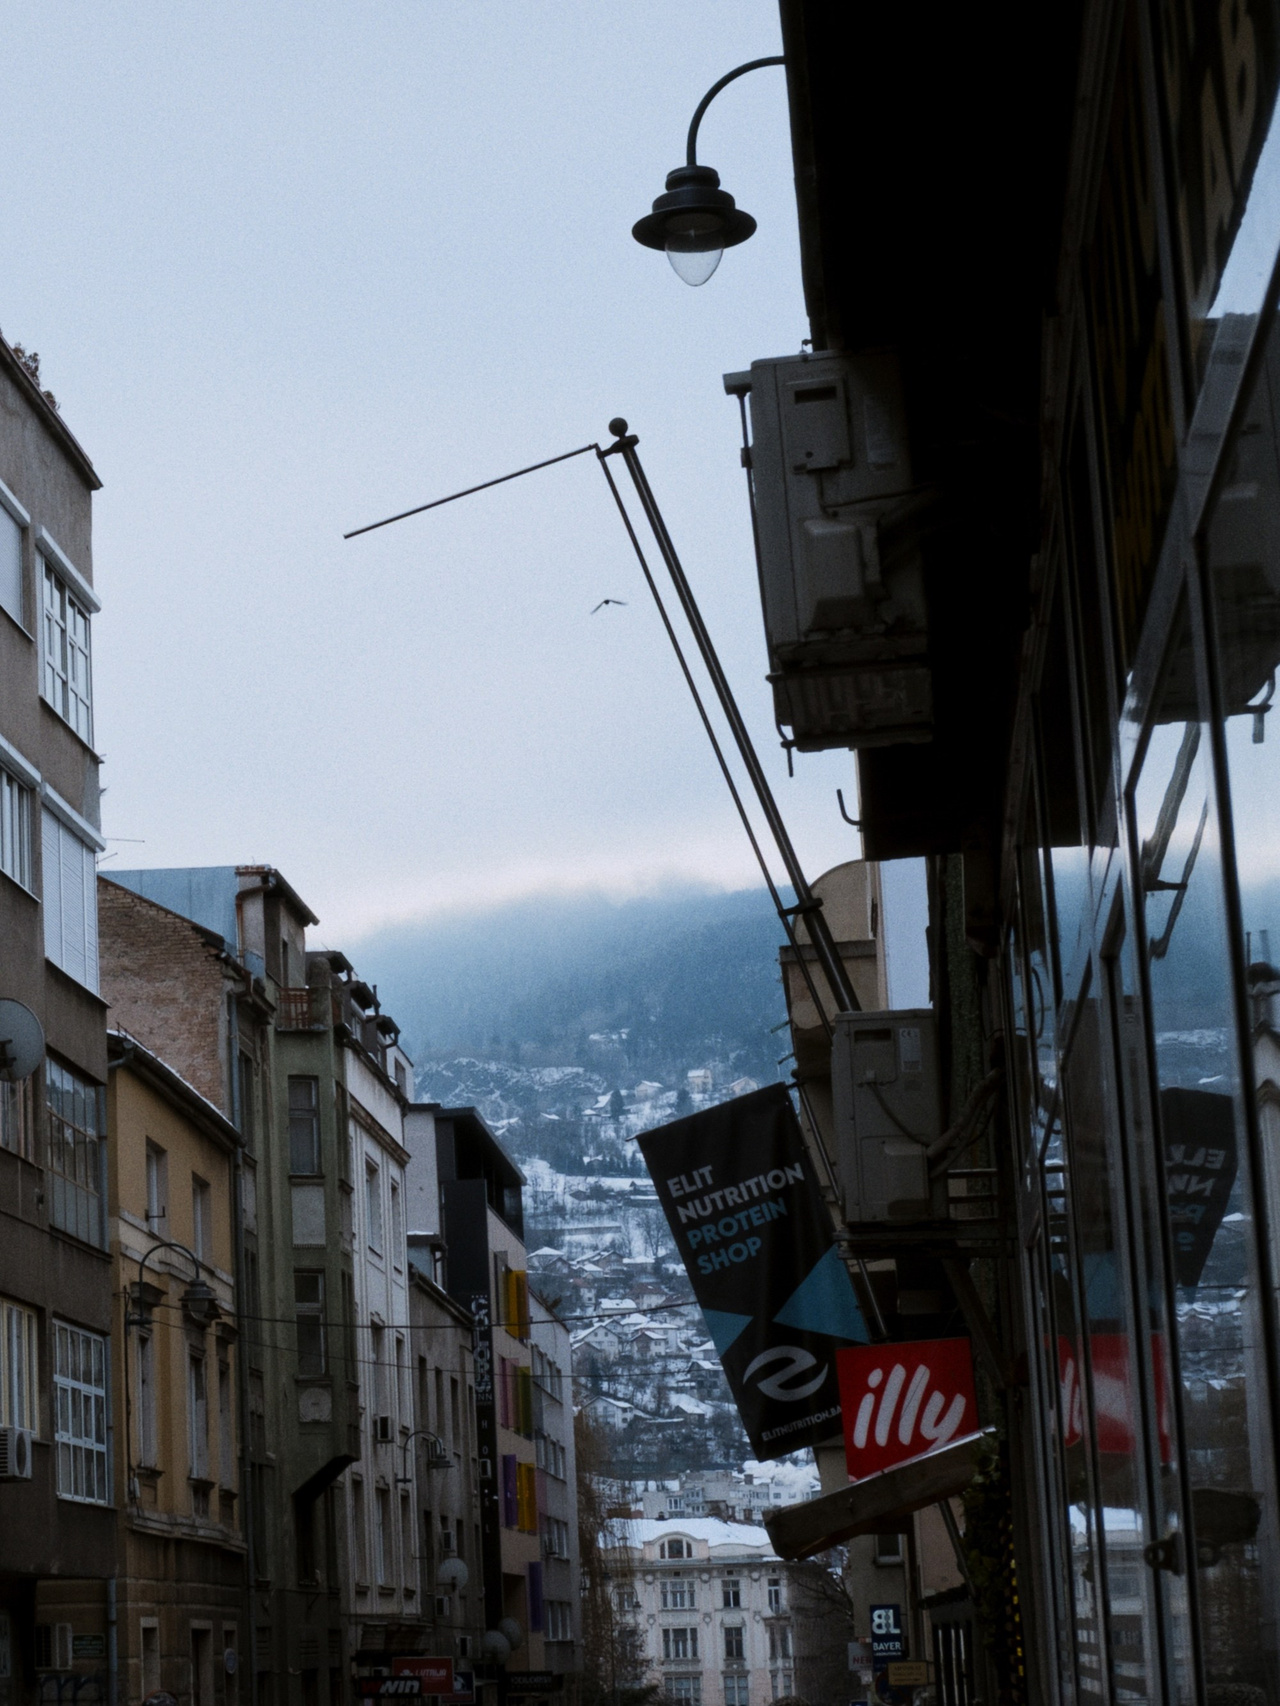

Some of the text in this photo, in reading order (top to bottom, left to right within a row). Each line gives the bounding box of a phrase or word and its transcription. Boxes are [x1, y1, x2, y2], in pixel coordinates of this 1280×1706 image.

[666, 1164, 714, 1198] ELIT
[676, 1162, 806, 1224] NUTRITION
[686, 1197, 789, 1250] PROTEIN
[697, 1236, 763, 1275] SHOP
[853, 1362, 967, 1452] illy
[873, 1642, 902, 1652] BAYER
